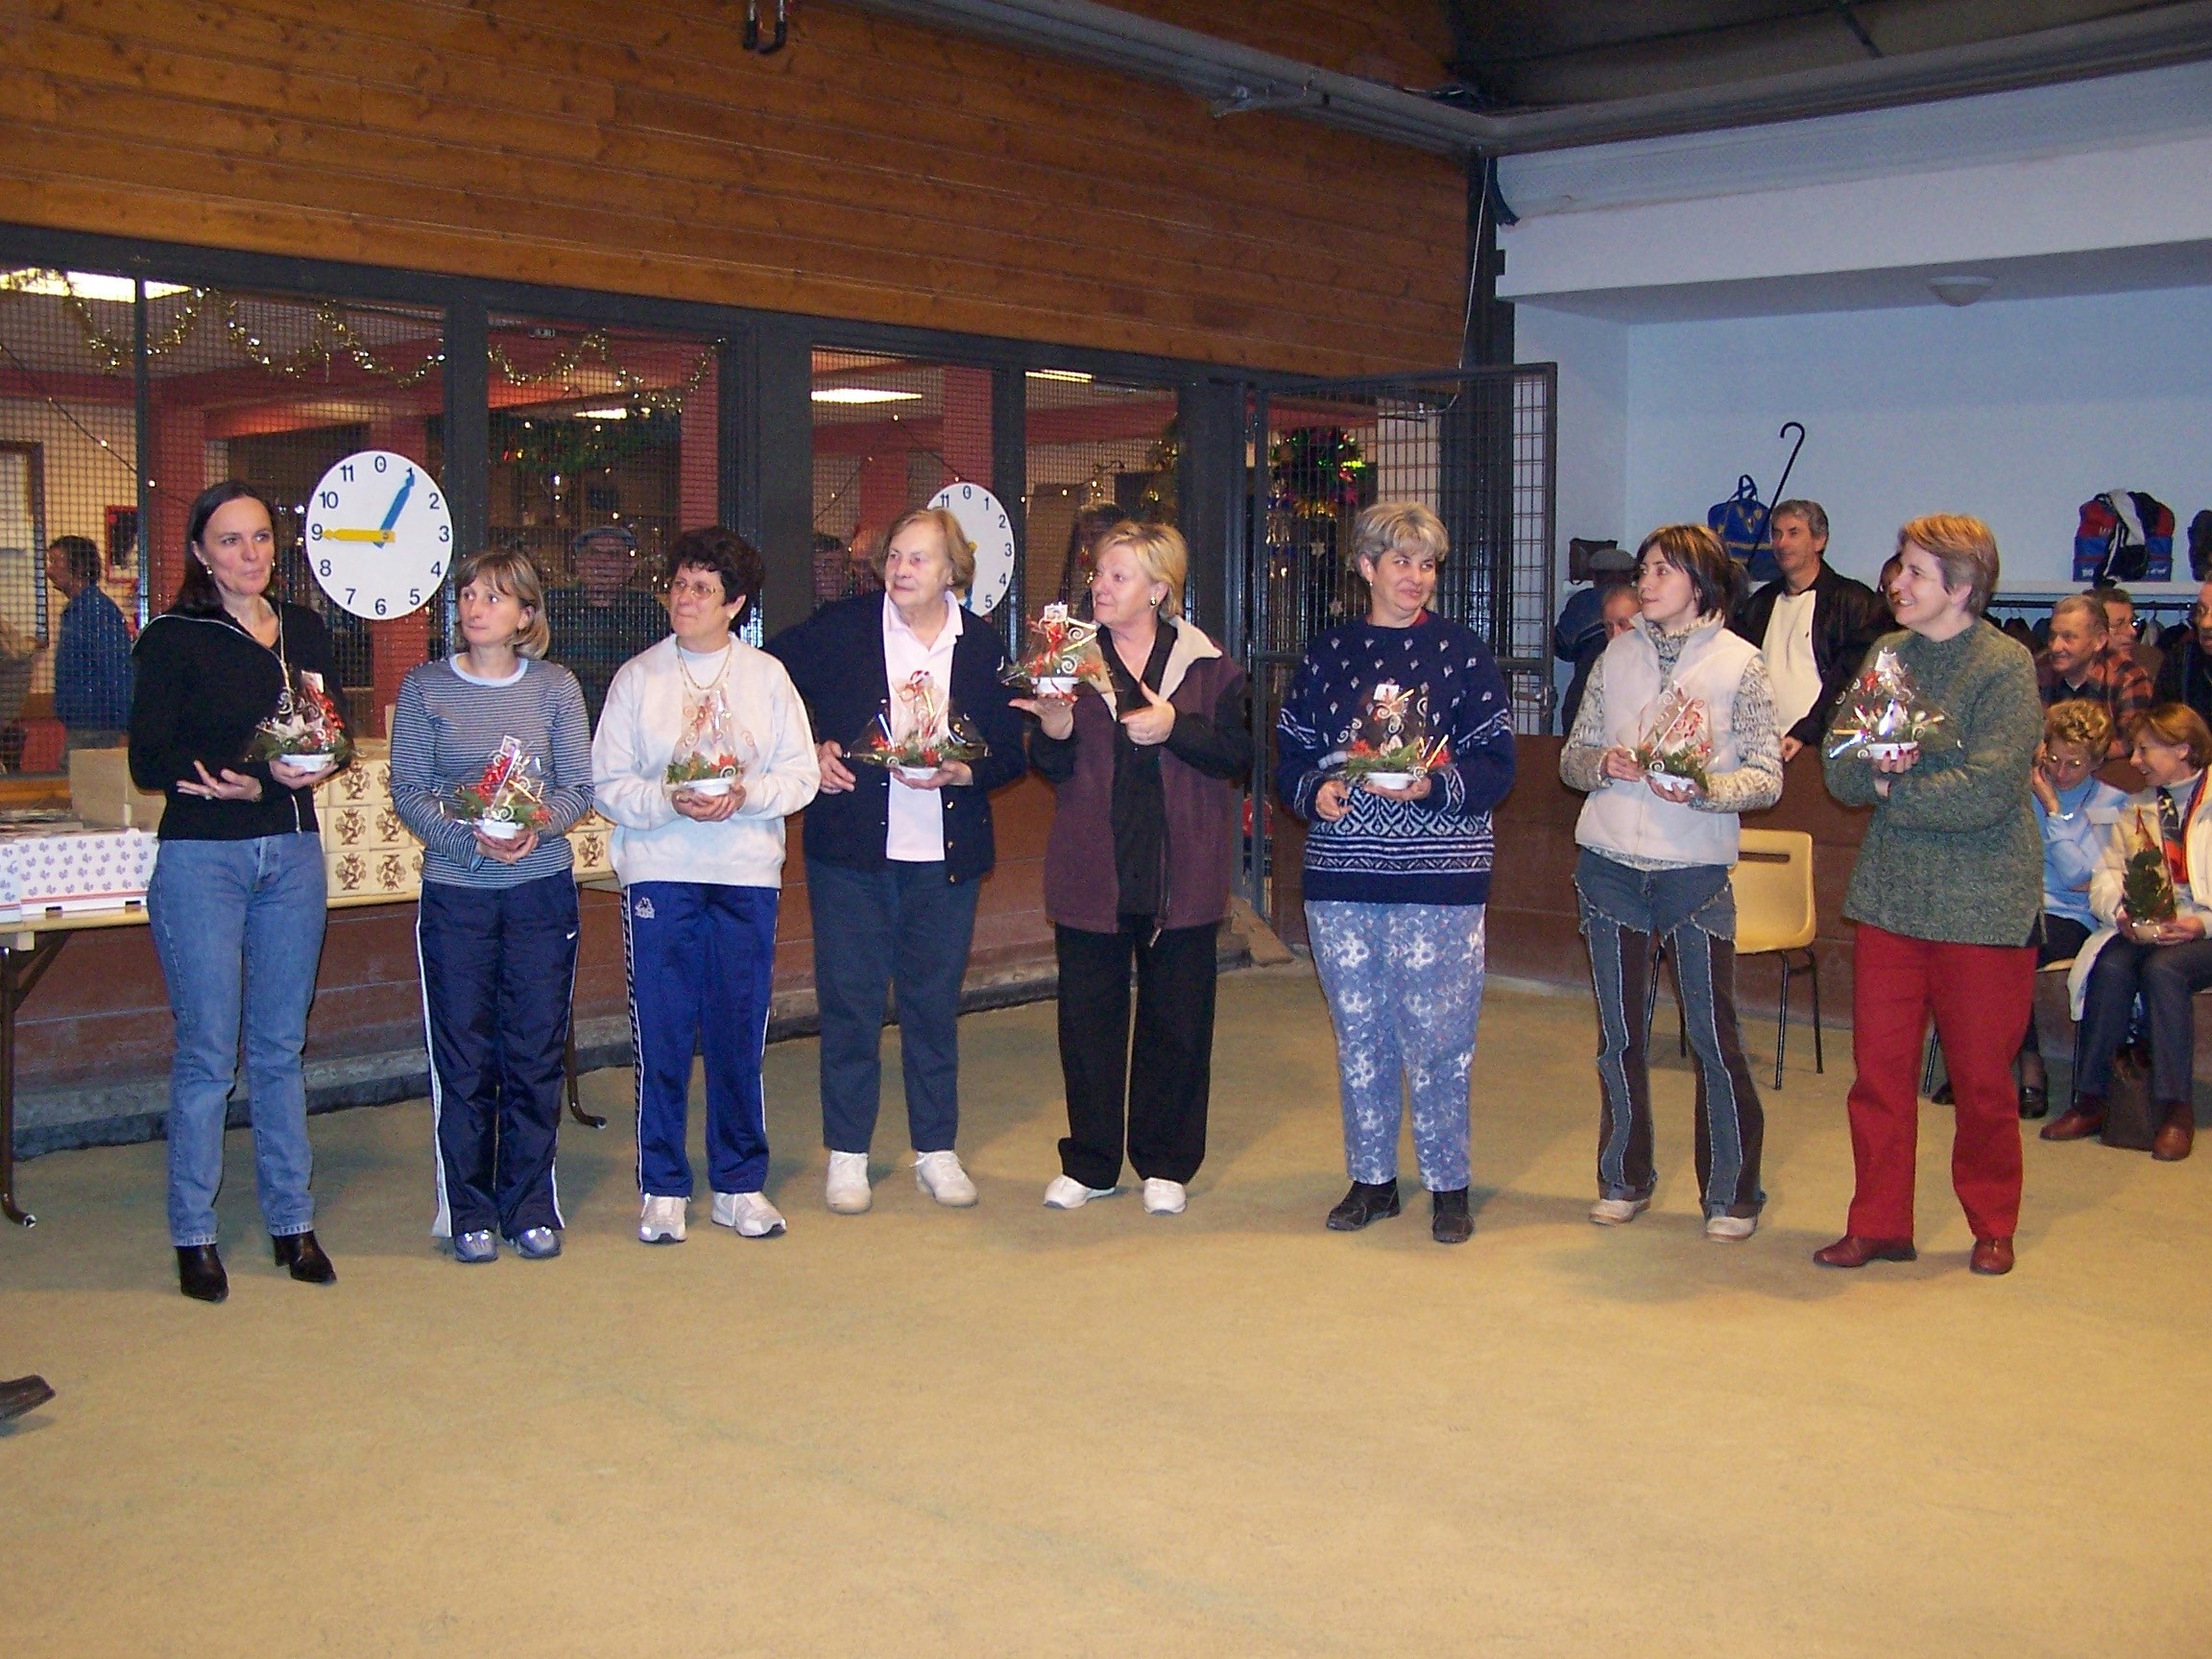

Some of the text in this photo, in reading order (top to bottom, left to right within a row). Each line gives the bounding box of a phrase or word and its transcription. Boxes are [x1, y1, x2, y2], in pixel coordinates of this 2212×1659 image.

[374, 456, 386, 472] 0
[340, 465, 353, 482] 11
[319, 492, 338, 509] 10
[963, 486, 972, 499] 0
[429, 493, 440, 509] 2
[940, 494, 950, 508] 11
[984, 497, 989, 511] 1
[998, 515, 1005, 528] 2
[312, 523, 323, 541] 9
[439, 525, 449, 542] 3
[1005, 543, 1012, 557] 3
[320, 560, 331, 576] 8
[431, 562, 441, 577] 4
[999, 573, 1006, 587] 4
[346, 589, 356, 605] 7
[410, 589, 420, 605] 5
[985, 594, 993, 608] 5
[375, 599, 386, 615] 6
